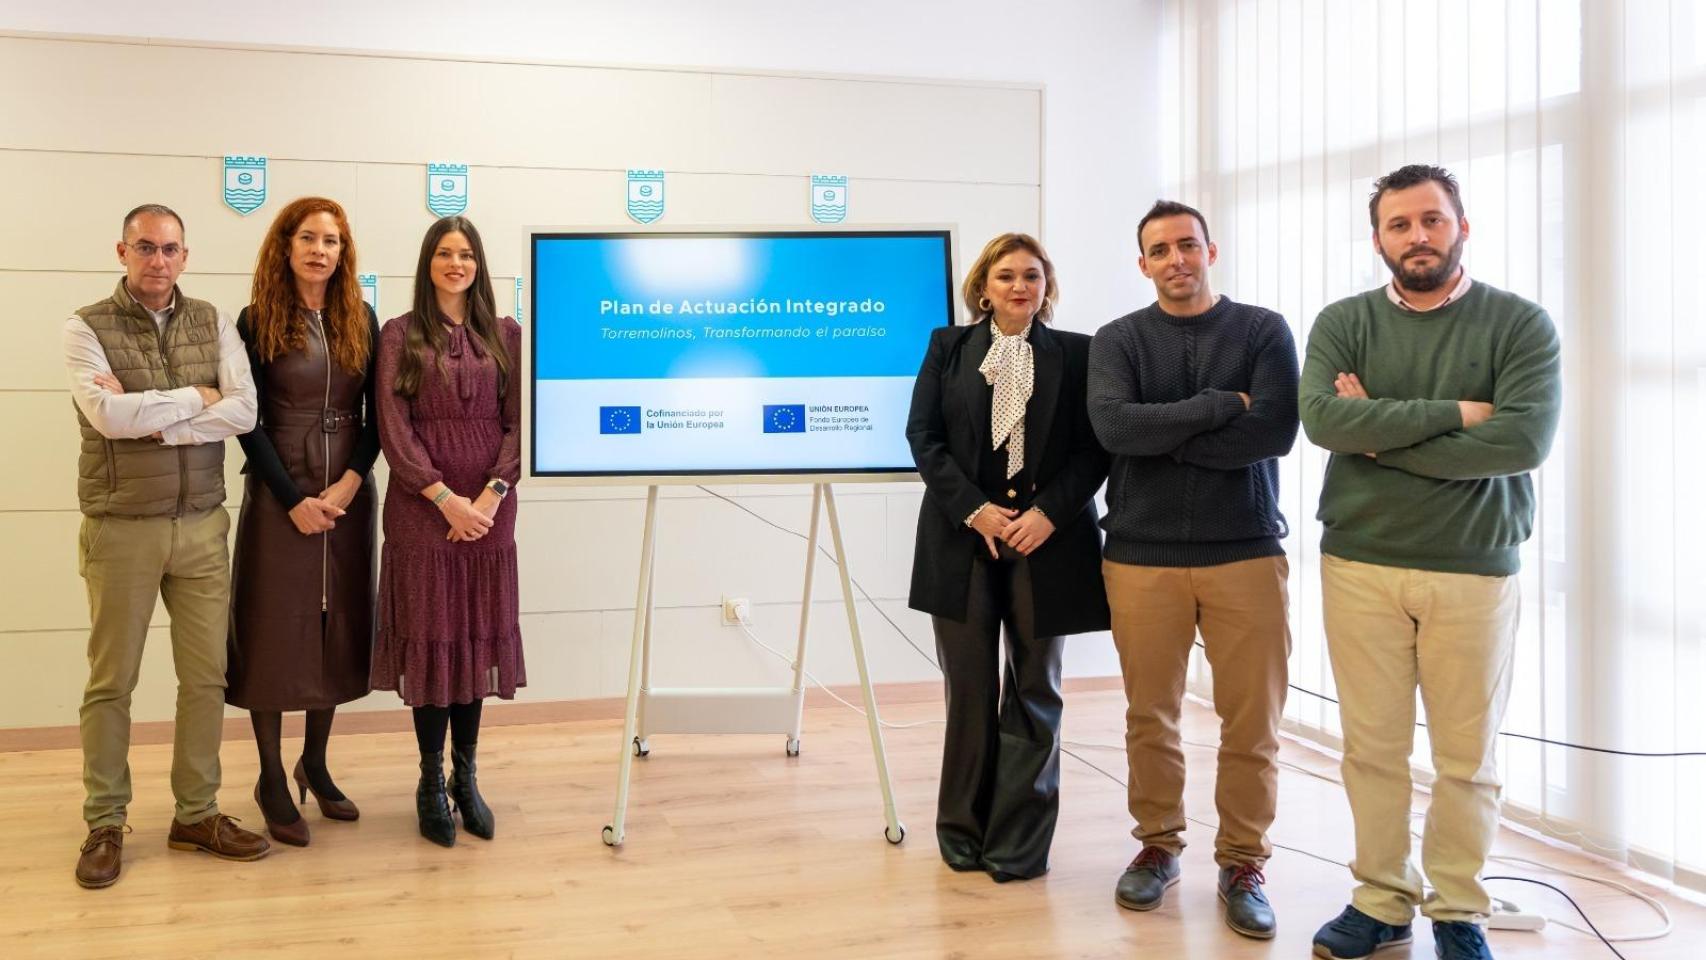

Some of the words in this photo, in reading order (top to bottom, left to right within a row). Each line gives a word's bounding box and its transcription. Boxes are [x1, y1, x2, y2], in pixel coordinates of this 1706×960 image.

[600, 300, 644, 315] Plan
[648, 299, 674, 315] de
[679, 298, 781, 315] Actuación
[786, 298, 886, 317] Integrado
[601, 327, 697, 341] Torremolinos,
[704, 325, 811, 339] Transformando
[816, 325, 829, 338] el
[832, 325, 887, 340] paraíso
[646, 409, 706, 418] Cofinanciado
[708, 410, 724, 419] por
[809, 404, 833, 413] UNIÓN
[834, 405, 869, 413] EUROPEA
[646, 420, 655, 429] la
[657, 418, 684, 429] Unión
[686, 420, 724, 430] Europea
[844, 424, 873, 433] Regional
